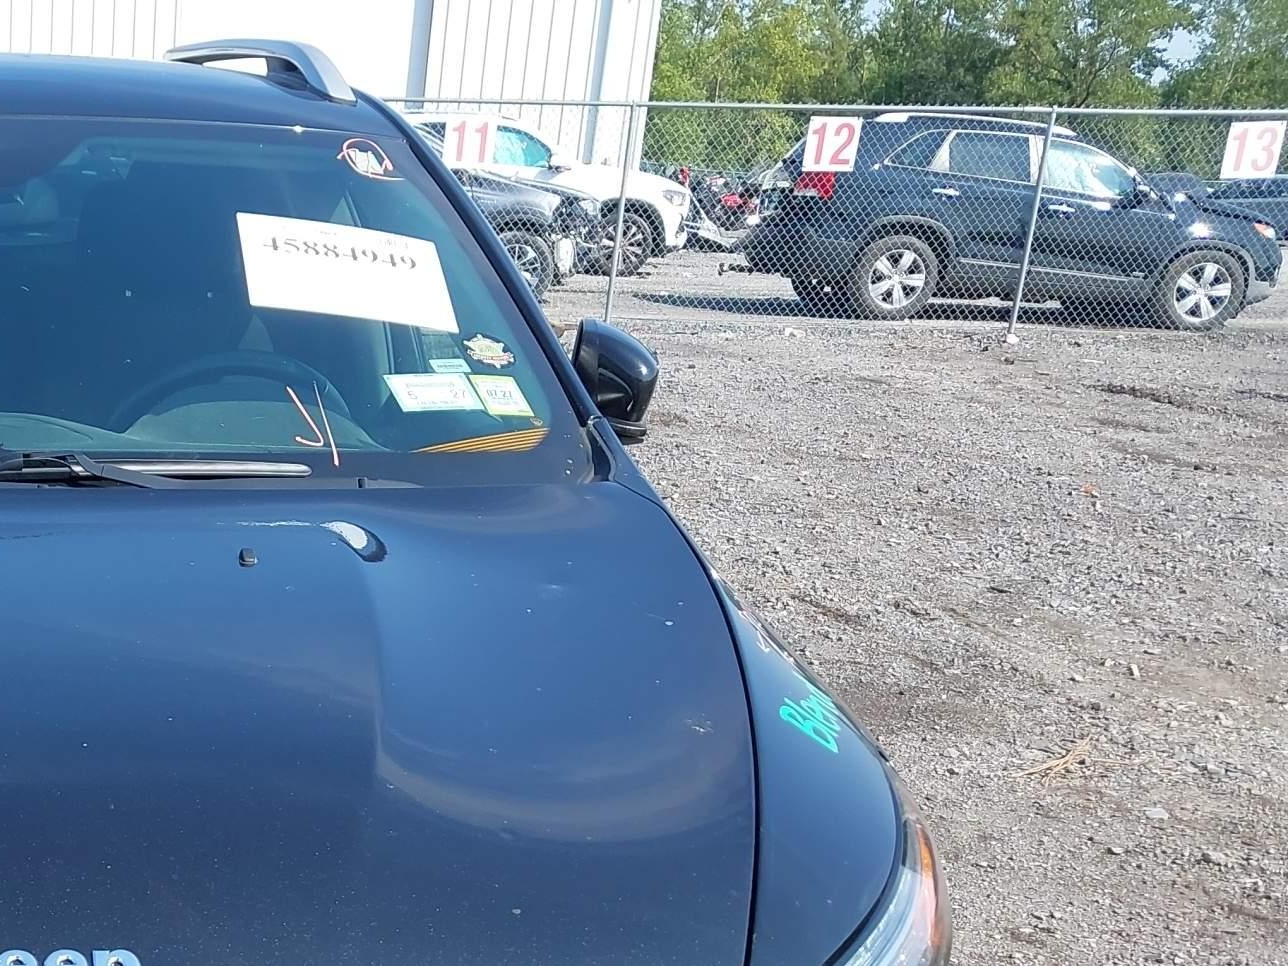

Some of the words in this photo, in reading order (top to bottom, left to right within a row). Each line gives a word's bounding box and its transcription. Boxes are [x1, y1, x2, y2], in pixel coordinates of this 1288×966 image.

[452, 120, 489, 163] 11
[812, 122, 855, 165] 12
[1232, 127, 1278, 171] 13
[263, 236, 417, 270] 45884949
